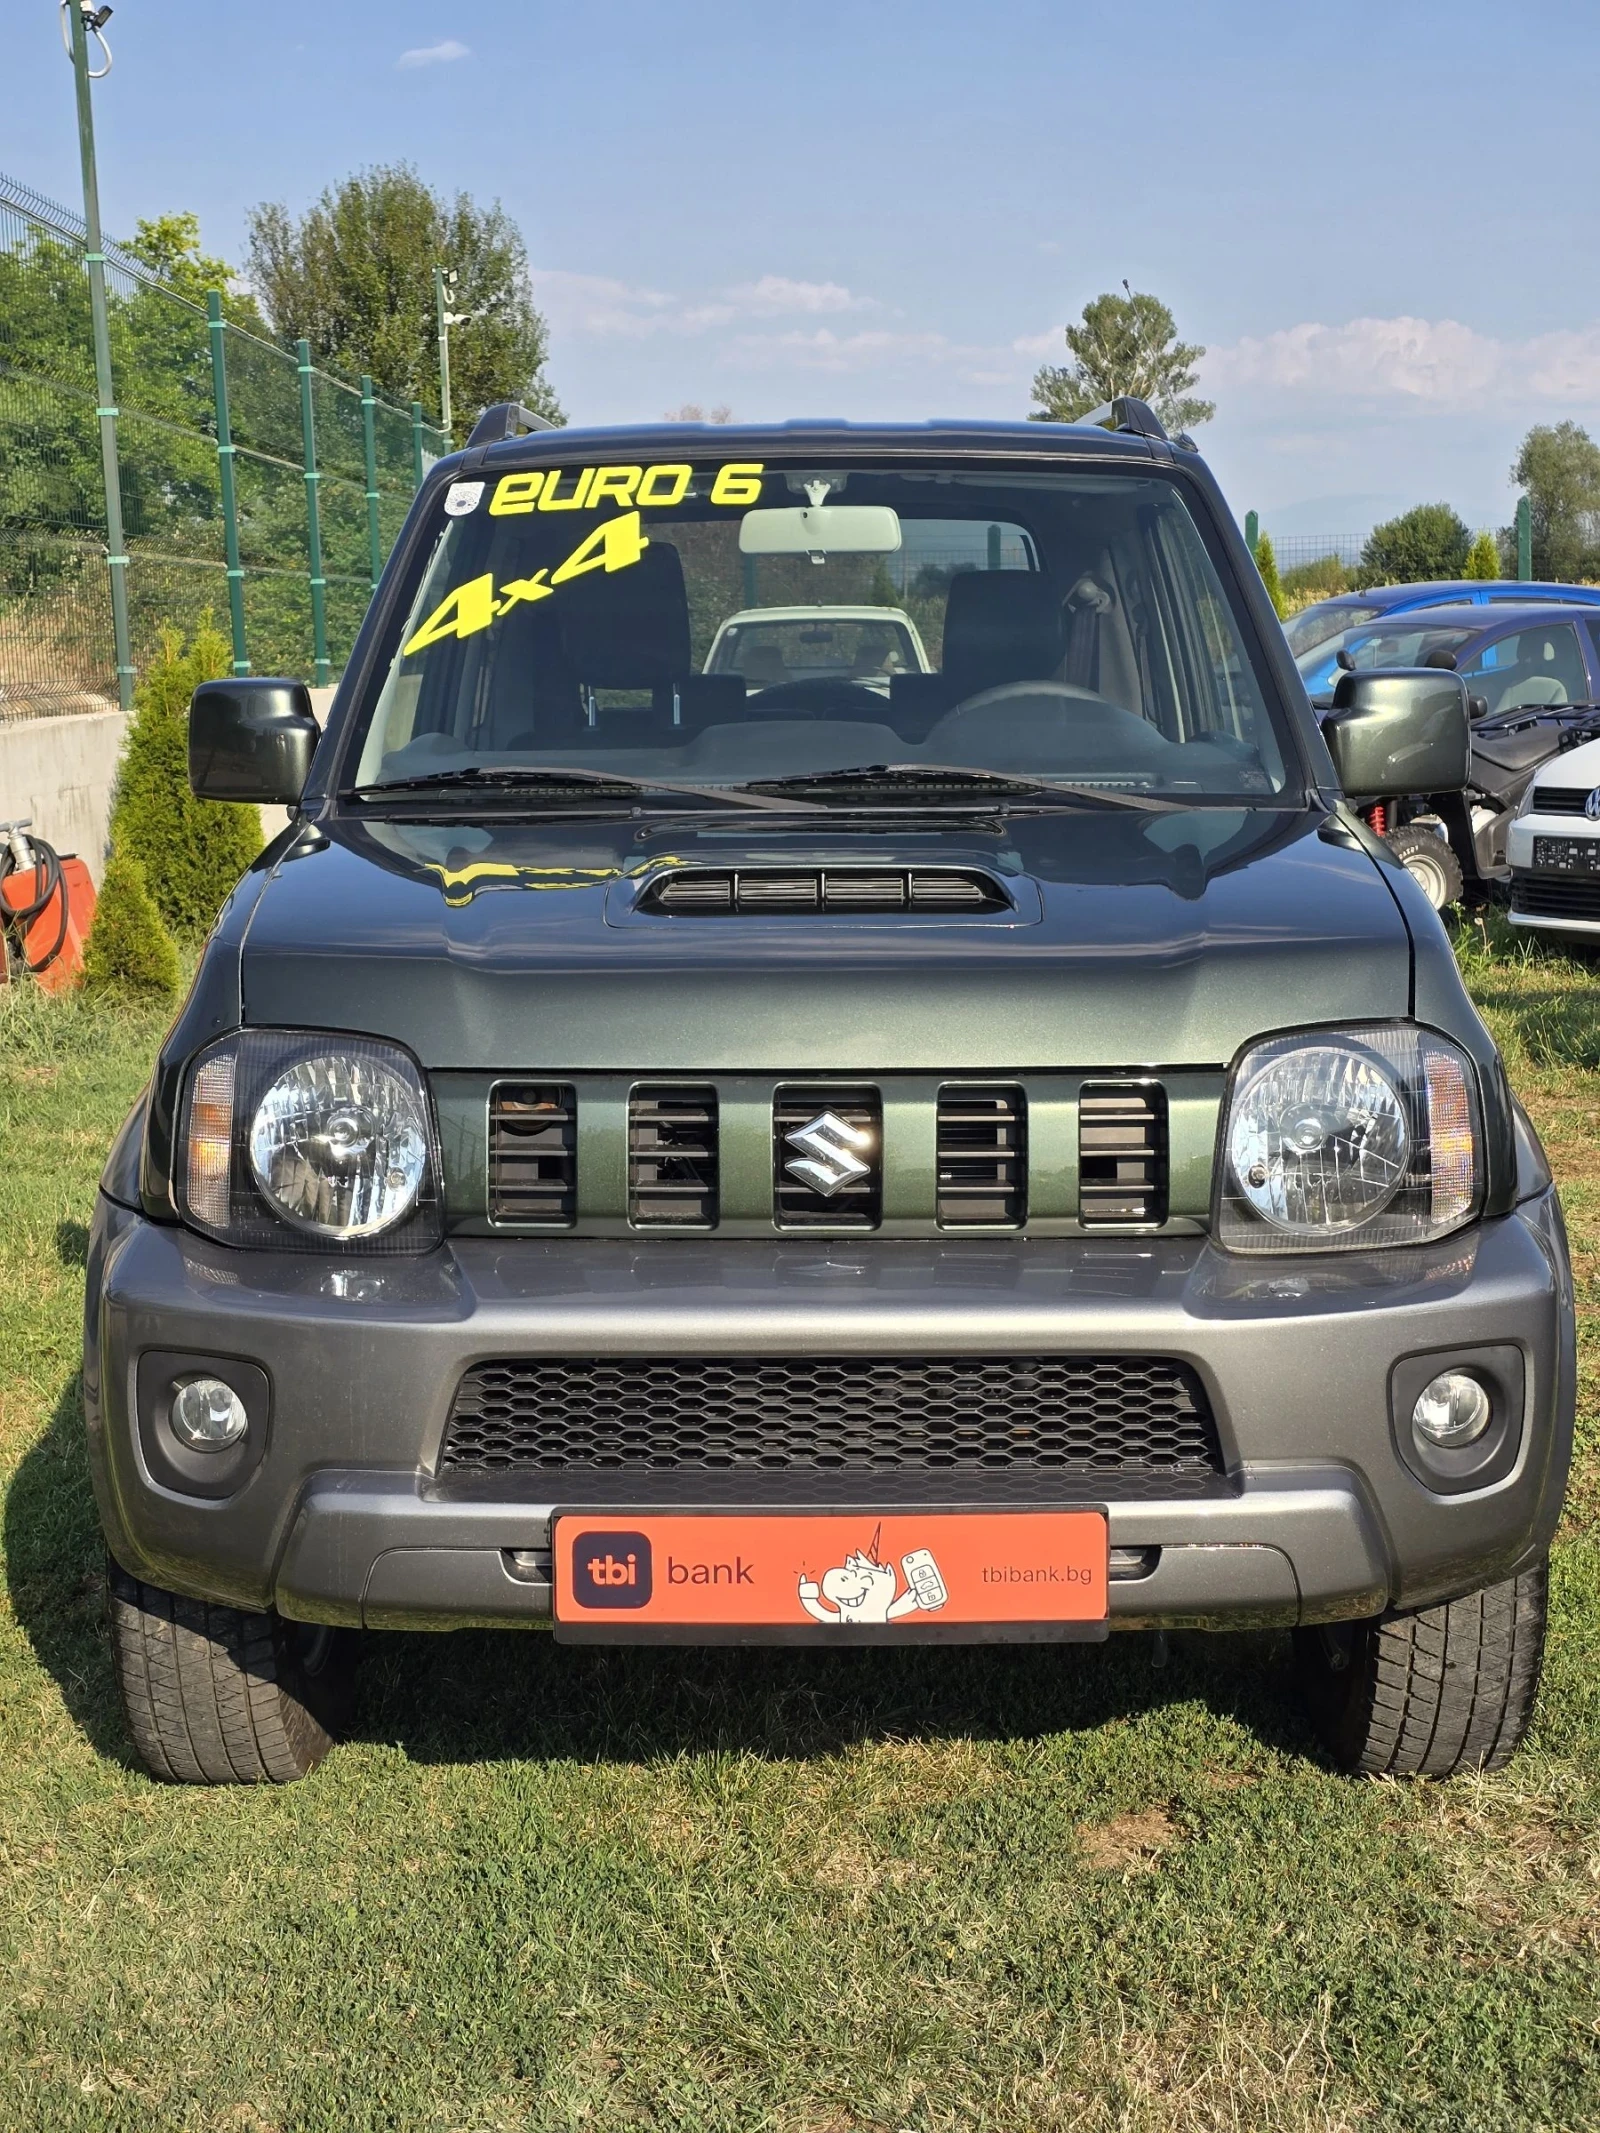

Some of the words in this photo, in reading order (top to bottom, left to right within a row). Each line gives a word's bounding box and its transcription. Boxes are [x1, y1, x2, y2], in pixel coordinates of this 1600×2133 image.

[710, 463, 764, 505] 6
[403, 510, 650, 656] 4x4
[588, 1554, 636, 1585] tbi
[667, 1556, 755, 1585] bank
[982, 1565, 1092, 1585] tbibank.bg
